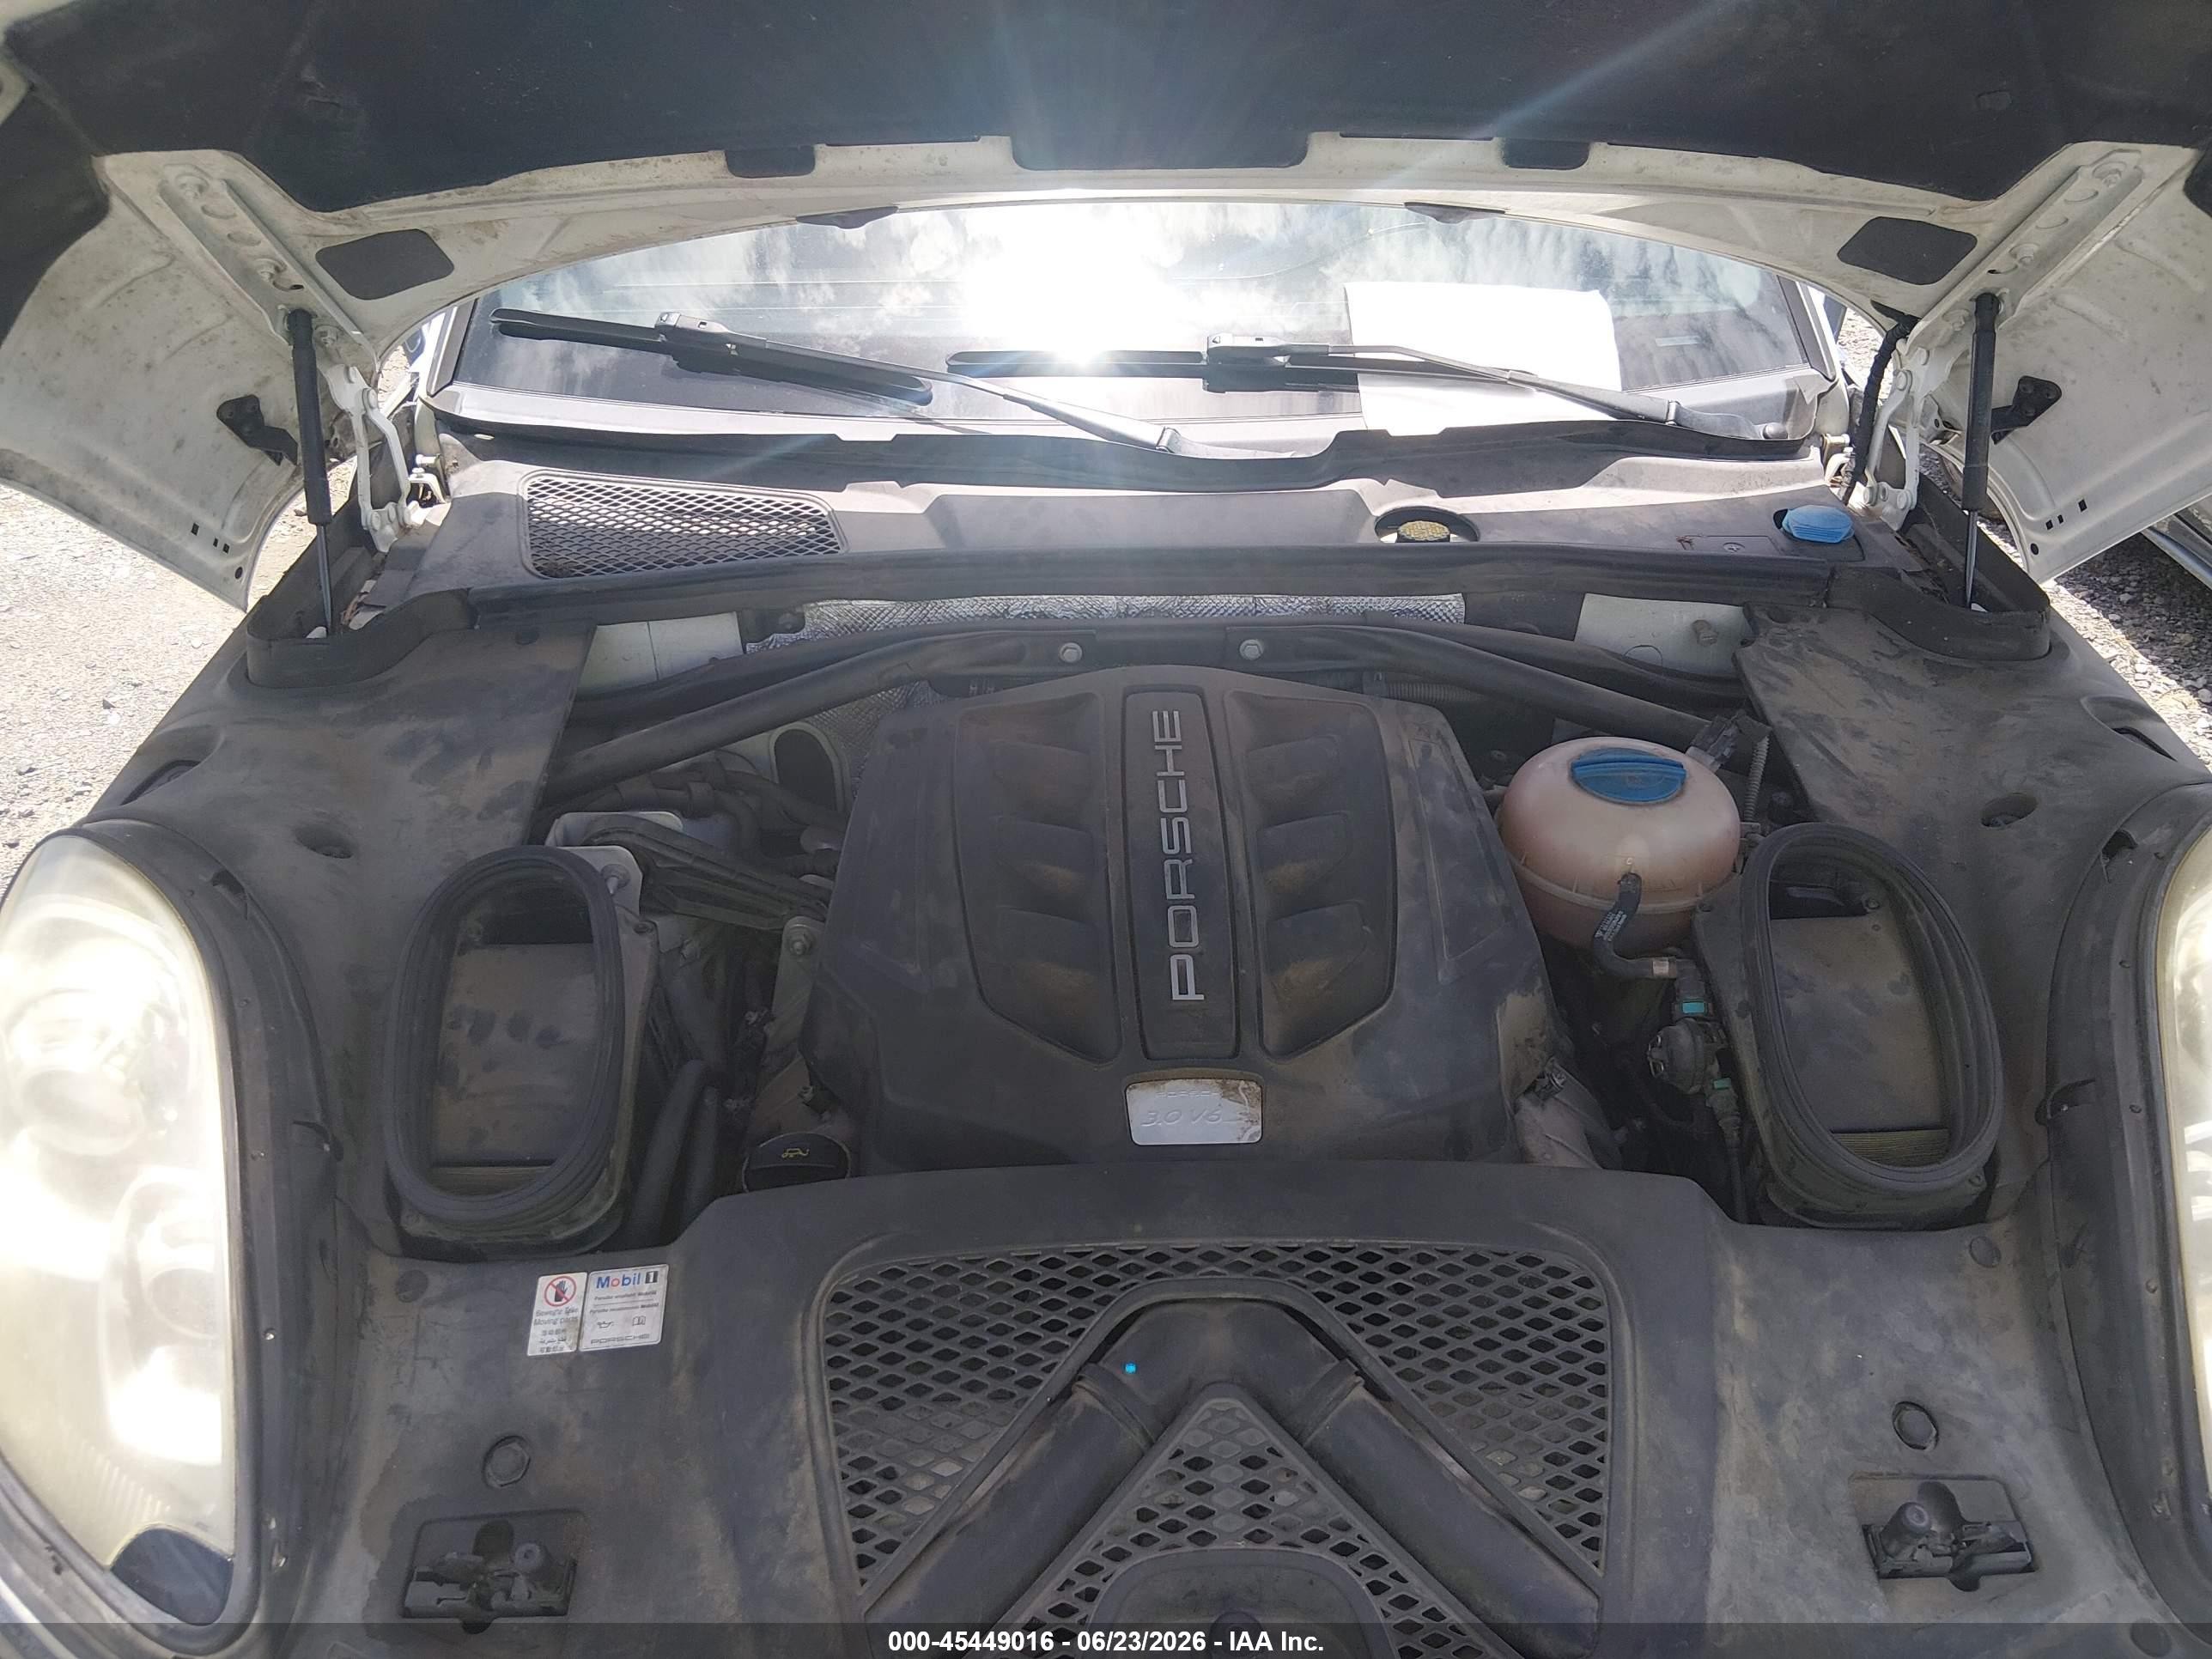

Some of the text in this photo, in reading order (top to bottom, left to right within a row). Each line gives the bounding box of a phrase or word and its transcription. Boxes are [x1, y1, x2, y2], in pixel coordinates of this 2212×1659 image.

[1152, 710, 1205, 1000] PORSCHE
[596, 1271, 658, 1289] Mobil 1
